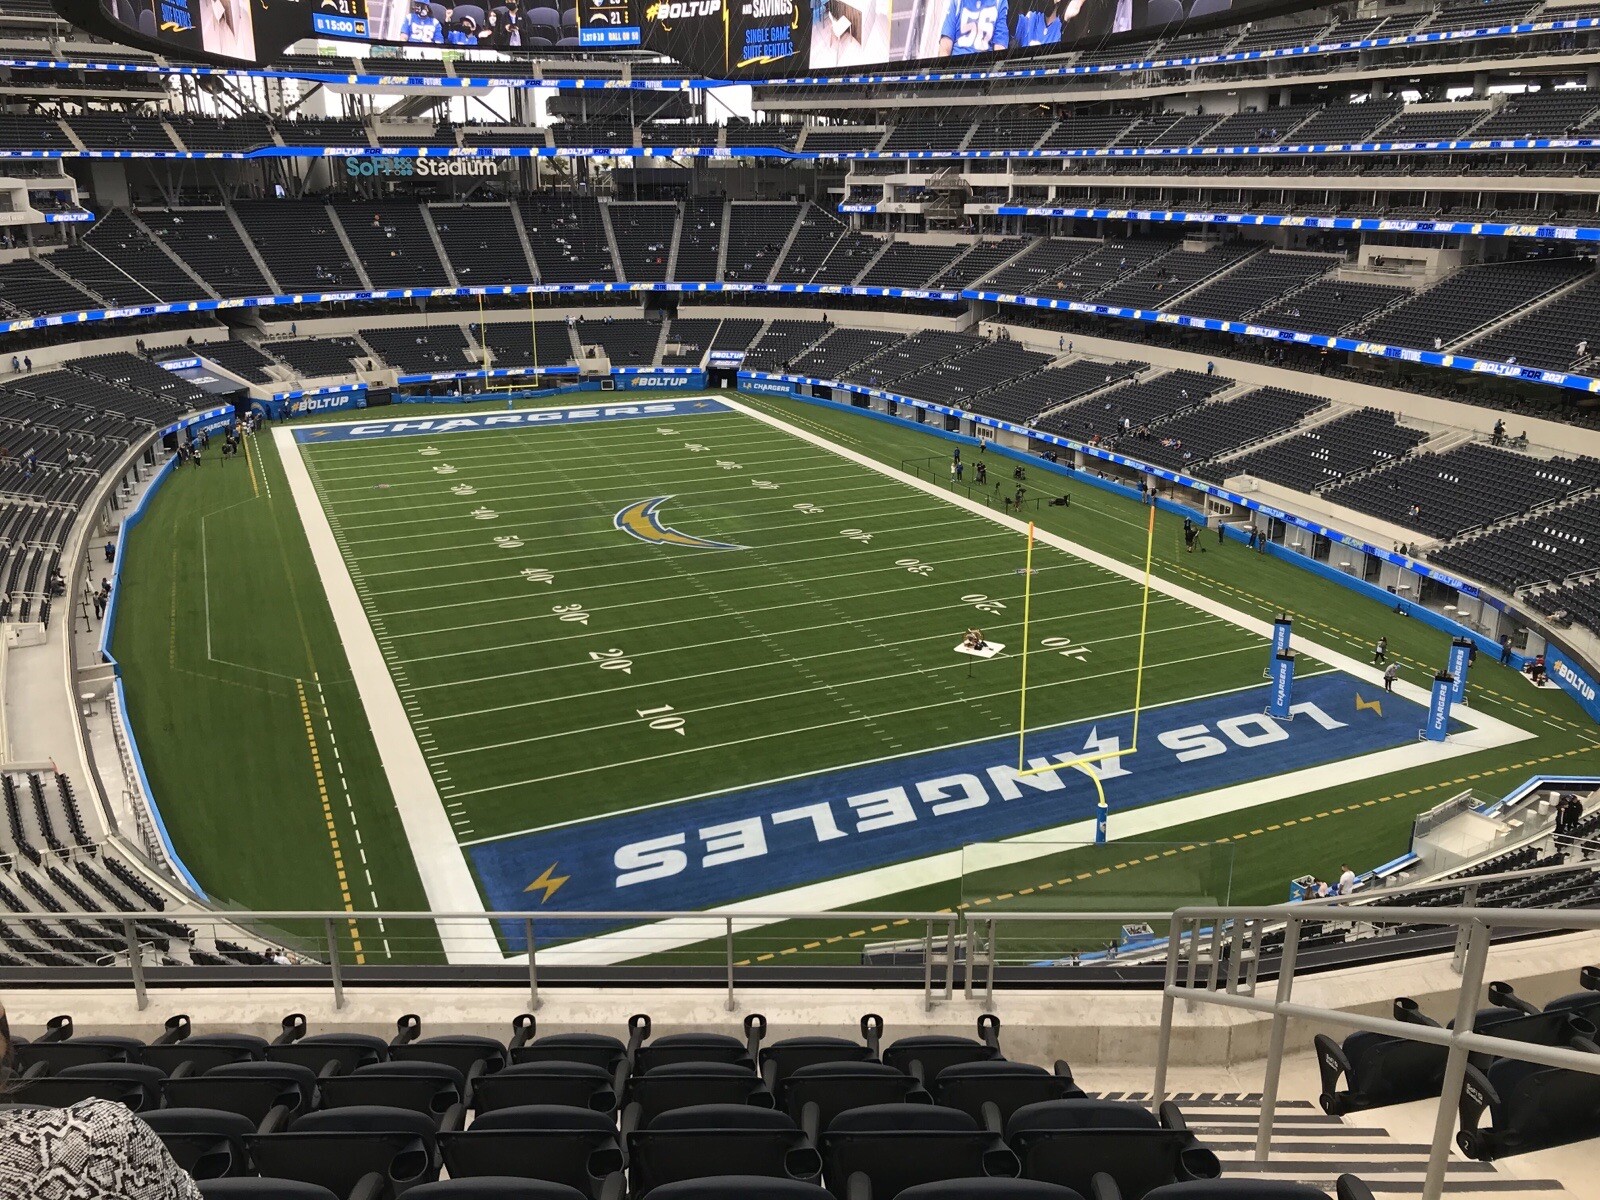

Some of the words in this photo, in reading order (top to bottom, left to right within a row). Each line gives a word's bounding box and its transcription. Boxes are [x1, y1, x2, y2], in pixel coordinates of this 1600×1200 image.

[611, 11, 621, 24] 21
[646, 0, 721, 22] #BOLTUP
[742, 4, 752, 14] AND
[753, 0, 793, 18] SAVINGS
[325, 19, 353, 32] 15:00
[411, 22, 435, 42] 56
[745, 28, 769, 44] SINGLE
[771, 26, 790, 42] GAME
[957, 6, 998, 50] 56
[743, 44, 762, 60] SUITE
[763, 41, 793, 58] RENTALS
[416, 157, 497, 176] Stadium
[140, 306, 155, 314] FOR
[1279, 331, 1294, 339] FOR
[631, 377, 688, 387] #BOLTUP
[1474, 361, 1521, 377] #BOLTUP
[1521, 368, 1542, 379] FOR
[1542, 373, 1567, 384] 2021
[743, 382, 752, 390] LA
[754, 383, 790, 392] CHARGERS
[291, 396, 349, 412] #BOLTUP
[350, 404, 676, 435] CHARGERS
[520, 568, 554, 582] 40
[895, 558, 934, 573] 30
[1462, 582, 1478, 594] FOR
[961, 594, 1007, 611] 20
[552, 603, 590, 622] 30
[1041, 637, 1092, 657] 10
[1277, 626, 1285, 650] GERS
[589, 648, 633, 670] 20
[1452, 649, 1464, 693] CHARGERS
[1277, 663, 1287, 707] CHARGERS
[1553, 660, 1596, 702] #BOLTUP
[1435, 683, 1448, 730] CHARGERS
[636, 703, 686, 730] 10
[1157, 702, 1349, 763] LOS
[614, 725, 1133, 888] ANGELES
[1464, 1140, 1469, 1150] 2
